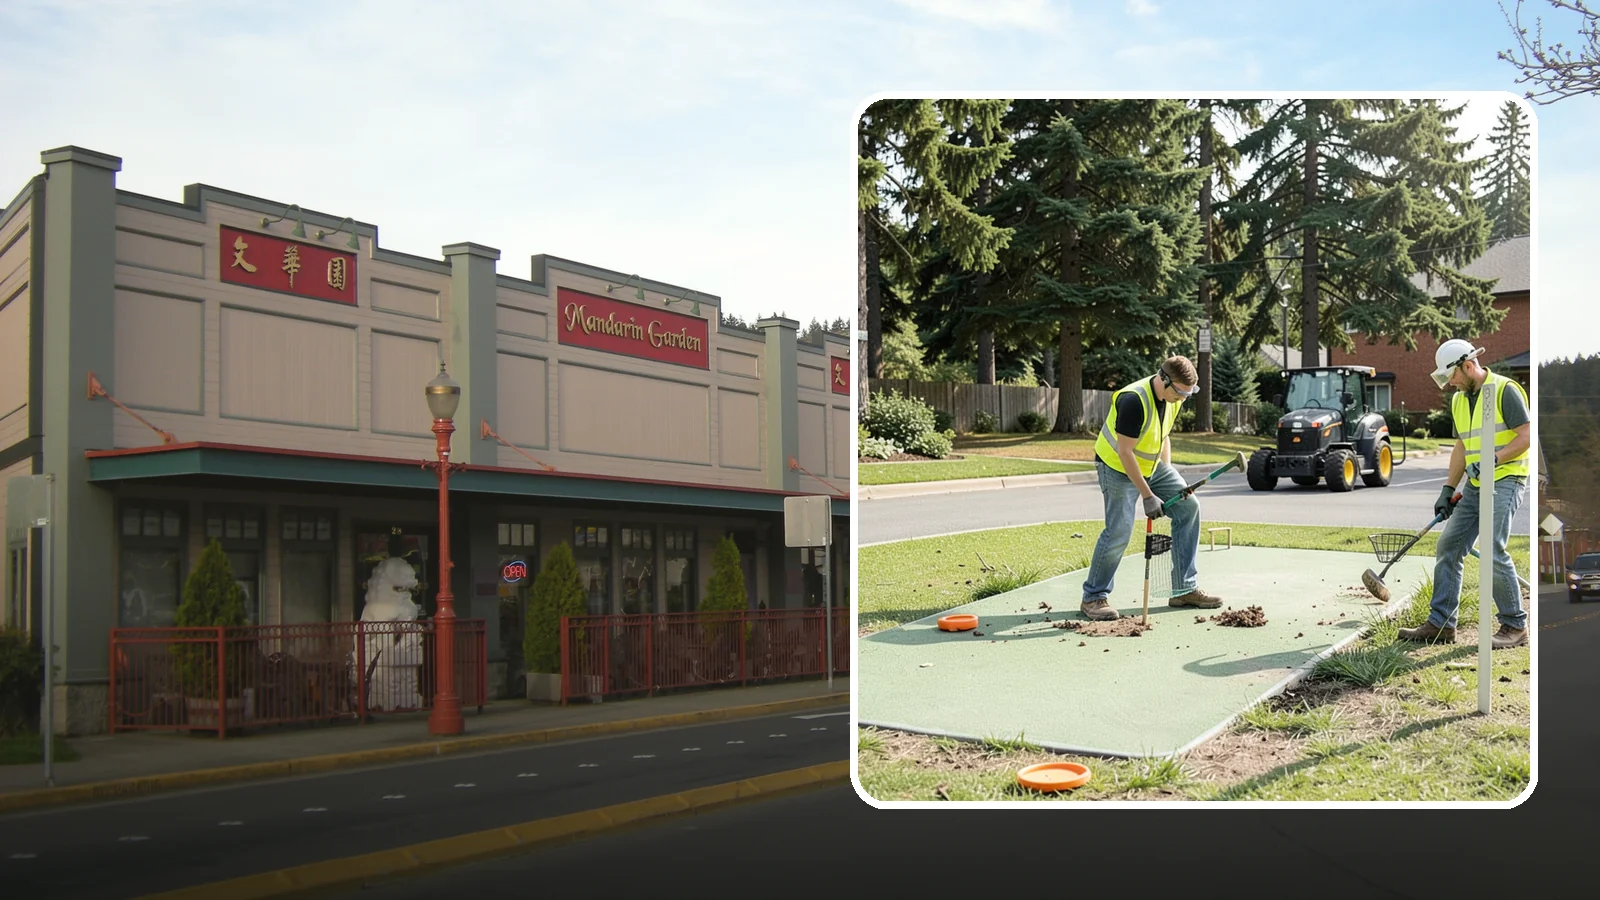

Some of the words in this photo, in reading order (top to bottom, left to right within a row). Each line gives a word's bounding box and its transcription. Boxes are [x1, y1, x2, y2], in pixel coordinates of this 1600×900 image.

[564, 302, 643, 340] Mandarin
[648, 320, 701, 352] Garden
[503, 565, 526, 578] OPEN
